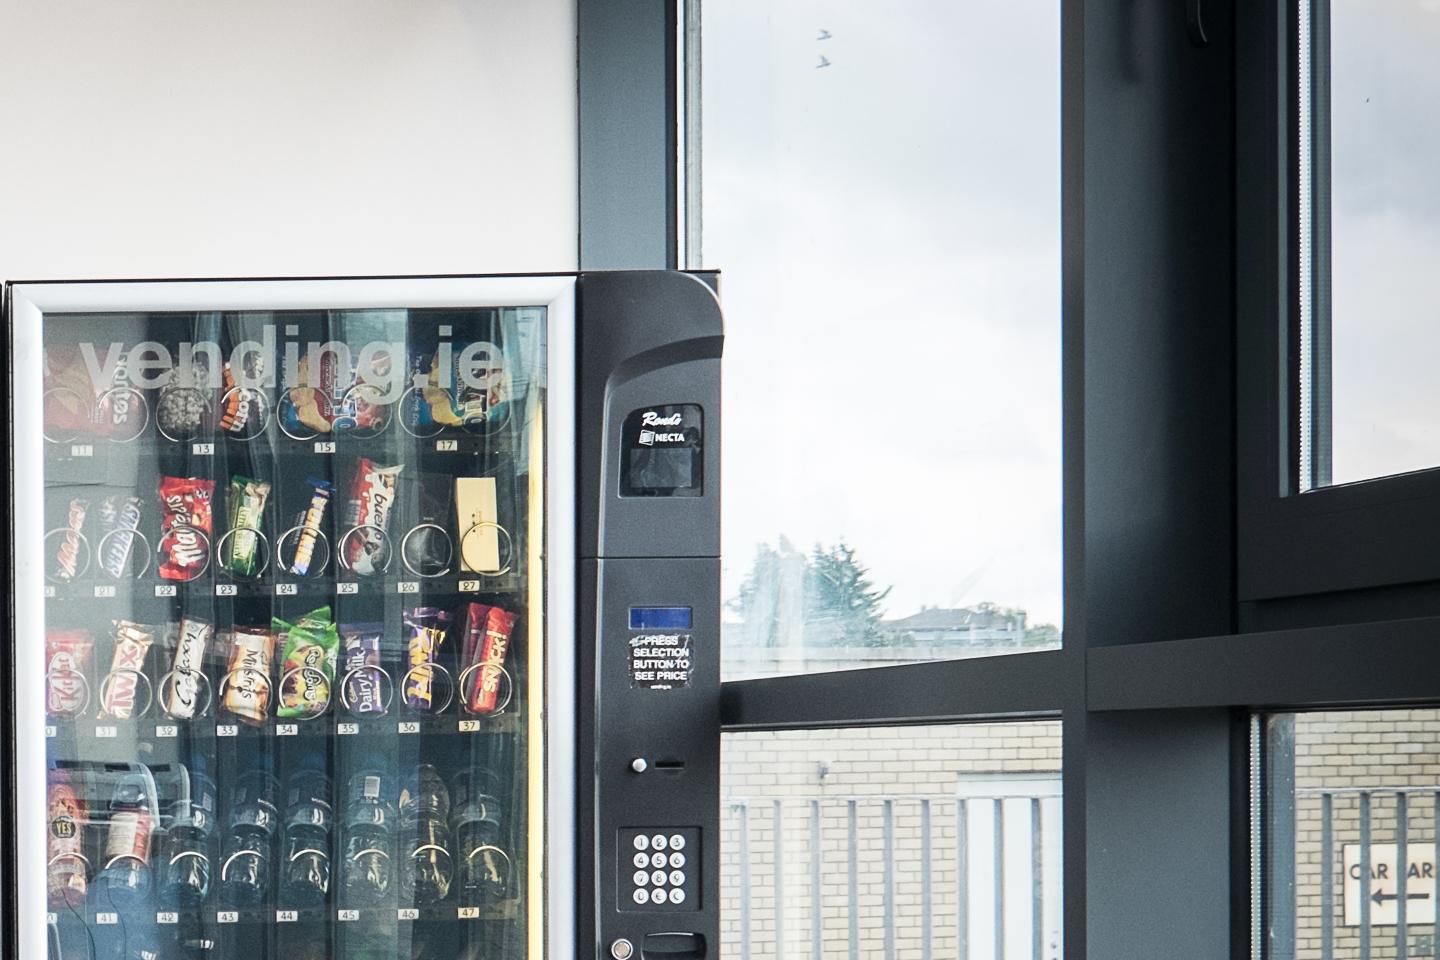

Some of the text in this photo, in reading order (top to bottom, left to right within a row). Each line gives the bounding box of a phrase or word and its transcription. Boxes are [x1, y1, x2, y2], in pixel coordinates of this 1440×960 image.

[78, 324, 503, 406] vending.ie
[655, 433, 685, 442] NECTA
[198, 445, 209, 454] 13
[320, 444, 331, 452] 15
[442, 441, 453, 450] 17
[373, 492, 388, 542] bueno
[644, 635, 678, 646] PRESS
[633, 648, 689, 657] SELECTION
[633, 660, 690, 668] BUTTON TO
[174, 631, 198, 708] Galaxy
[634, 671, 688, 680] SEE PRICE
[358, 677, 373, 713] Dairy
[57, 822, 72, 835] YES
